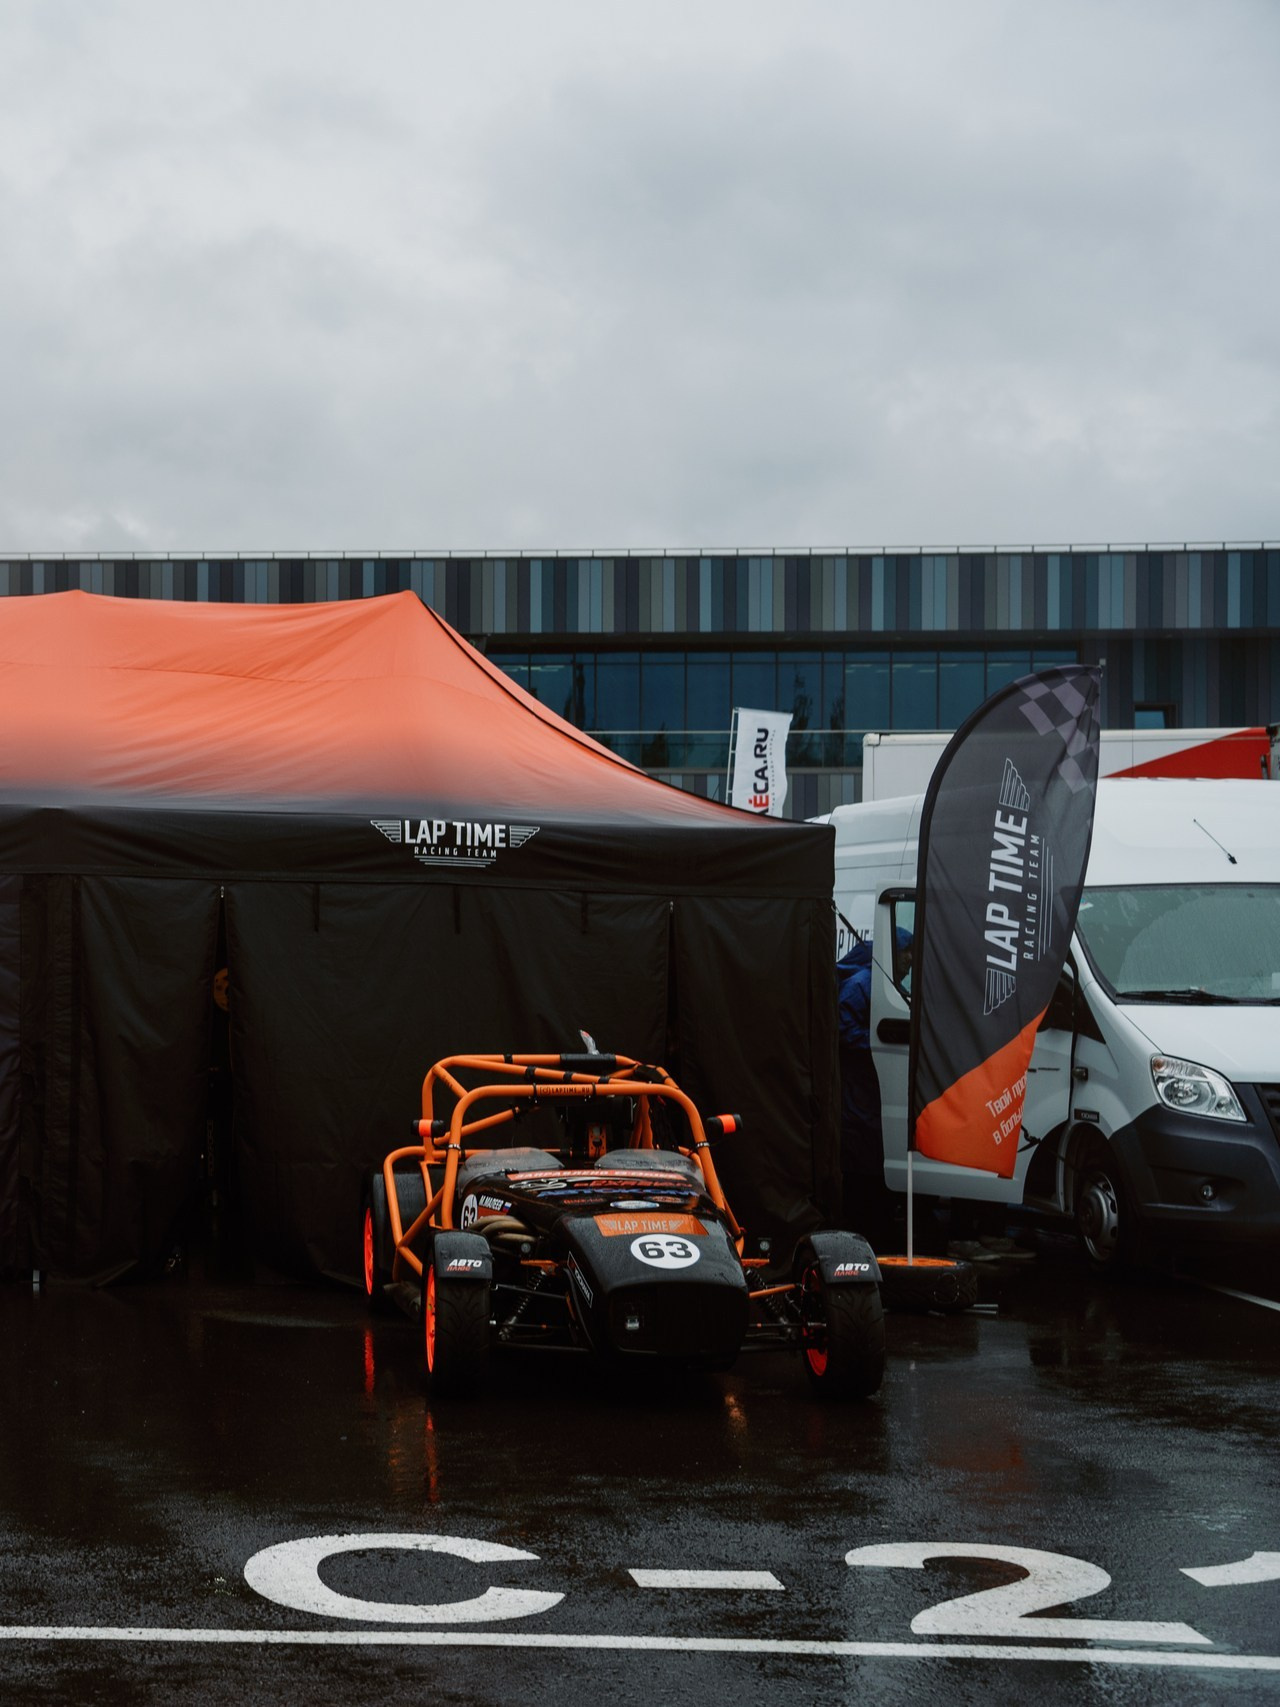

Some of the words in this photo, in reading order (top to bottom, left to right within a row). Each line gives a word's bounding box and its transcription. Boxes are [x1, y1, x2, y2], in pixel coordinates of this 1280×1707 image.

[405, 819, 447, 844] LAP
[452, 821, 507, 848] TIME
[414, 846, 458, 857] RACING
[467, 848, 497, 858] TEAM
[988, 810, 1028, 894] TIME
[1028, 834, 1041, 880] TEAM
[984, 902, 1021, 972] LAP
[1023, 893, 1037, 961] RACING
[985, 1087, 1013, 1118] Твой
[992, 1130, 1002, 1145] в
[617, 1219, 638, 1232] LAP
[641, 1219, 668, 1232] TIME
[638, 1241, 693, 1259] 63
[449, 1258, 483, 1268] АВТО
[835, 1263, 870, 1271] АВТО
